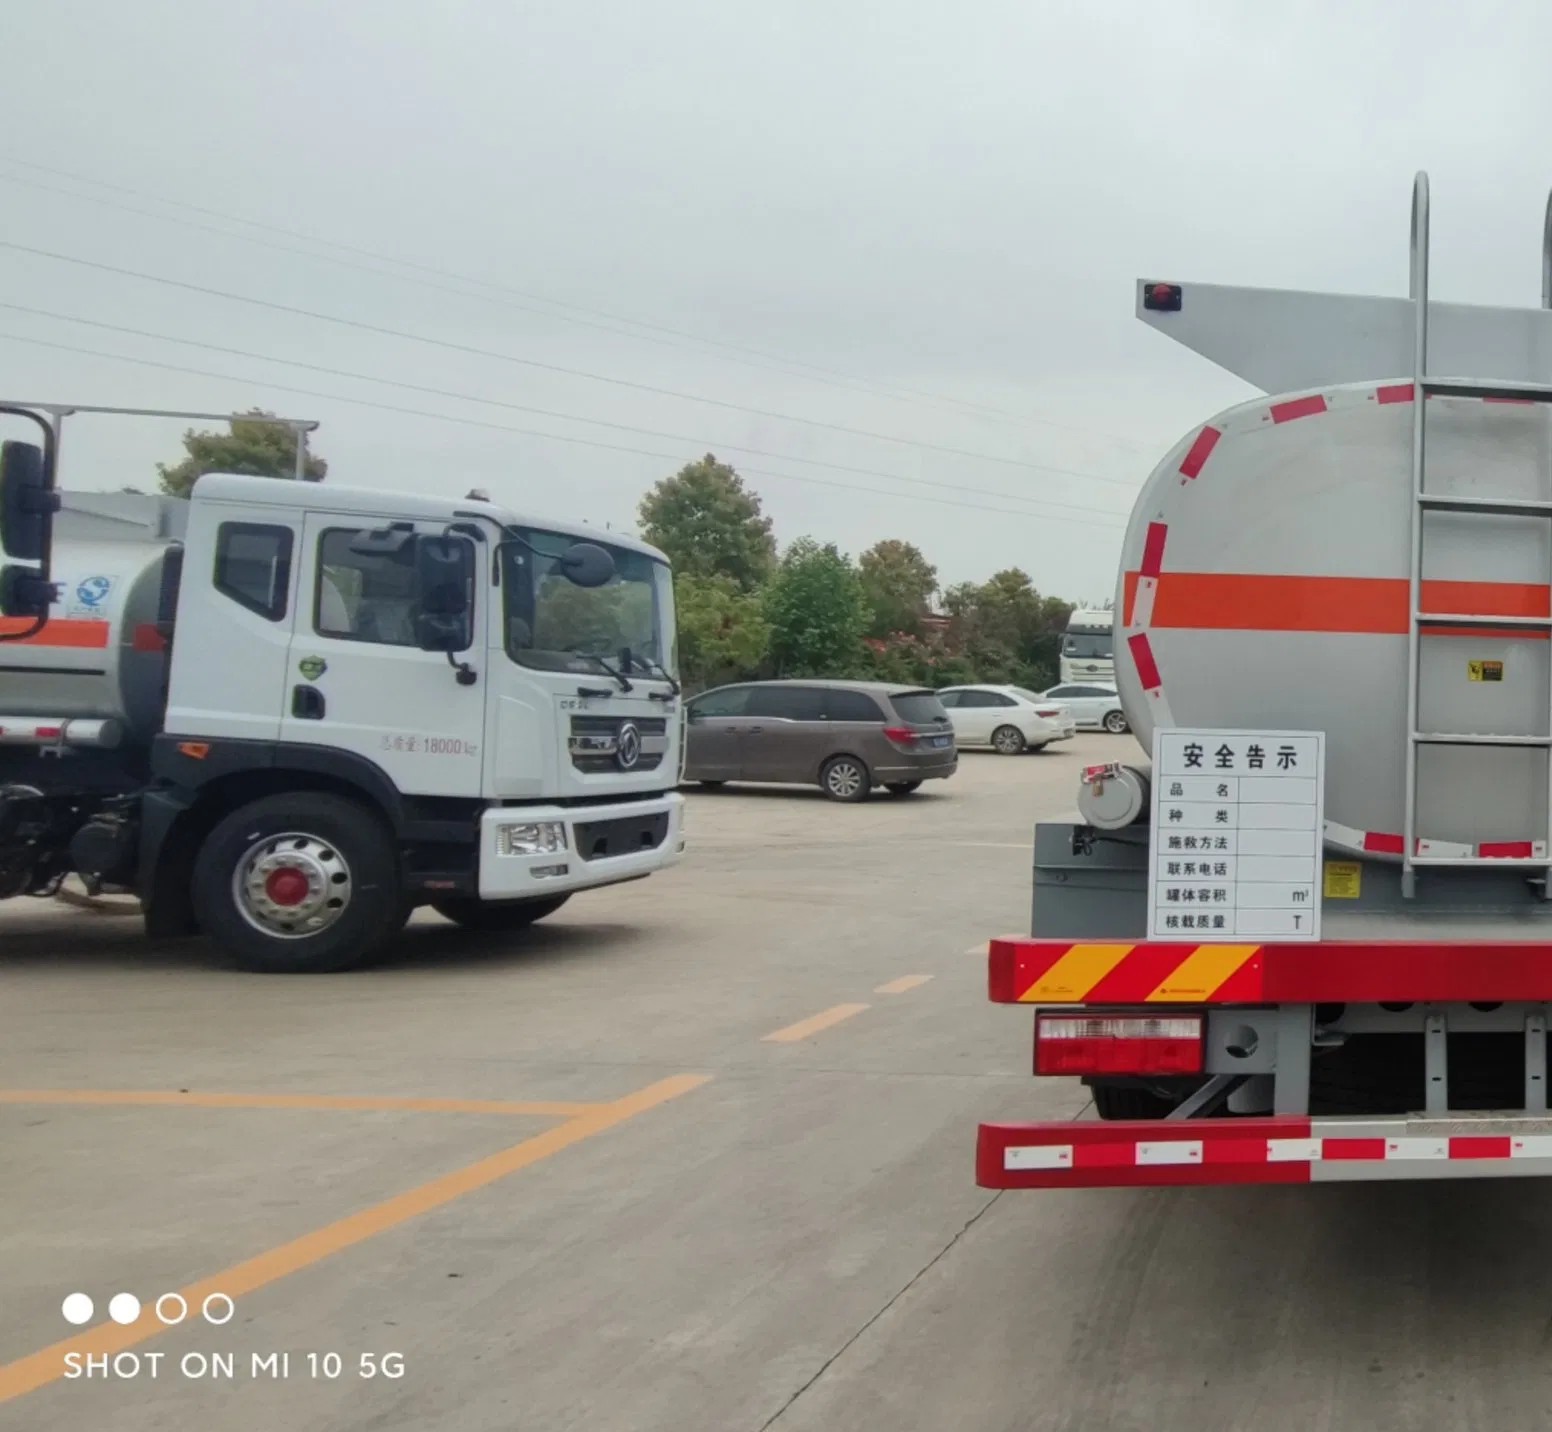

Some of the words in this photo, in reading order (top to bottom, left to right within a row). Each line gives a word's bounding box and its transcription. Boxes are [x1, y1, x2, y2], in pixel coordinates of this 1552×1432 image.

[1183, 743, 1297, 770] 安全告示
[1168, 836, 1228, 850] 施救方法
[1167, 862, 1228, 876] 联系电话
[1165, 888, 1227, 902] 罐体容积
[1165, 914, 1226, 929] 核载质量
[1293, 915, 1302, 930] T
